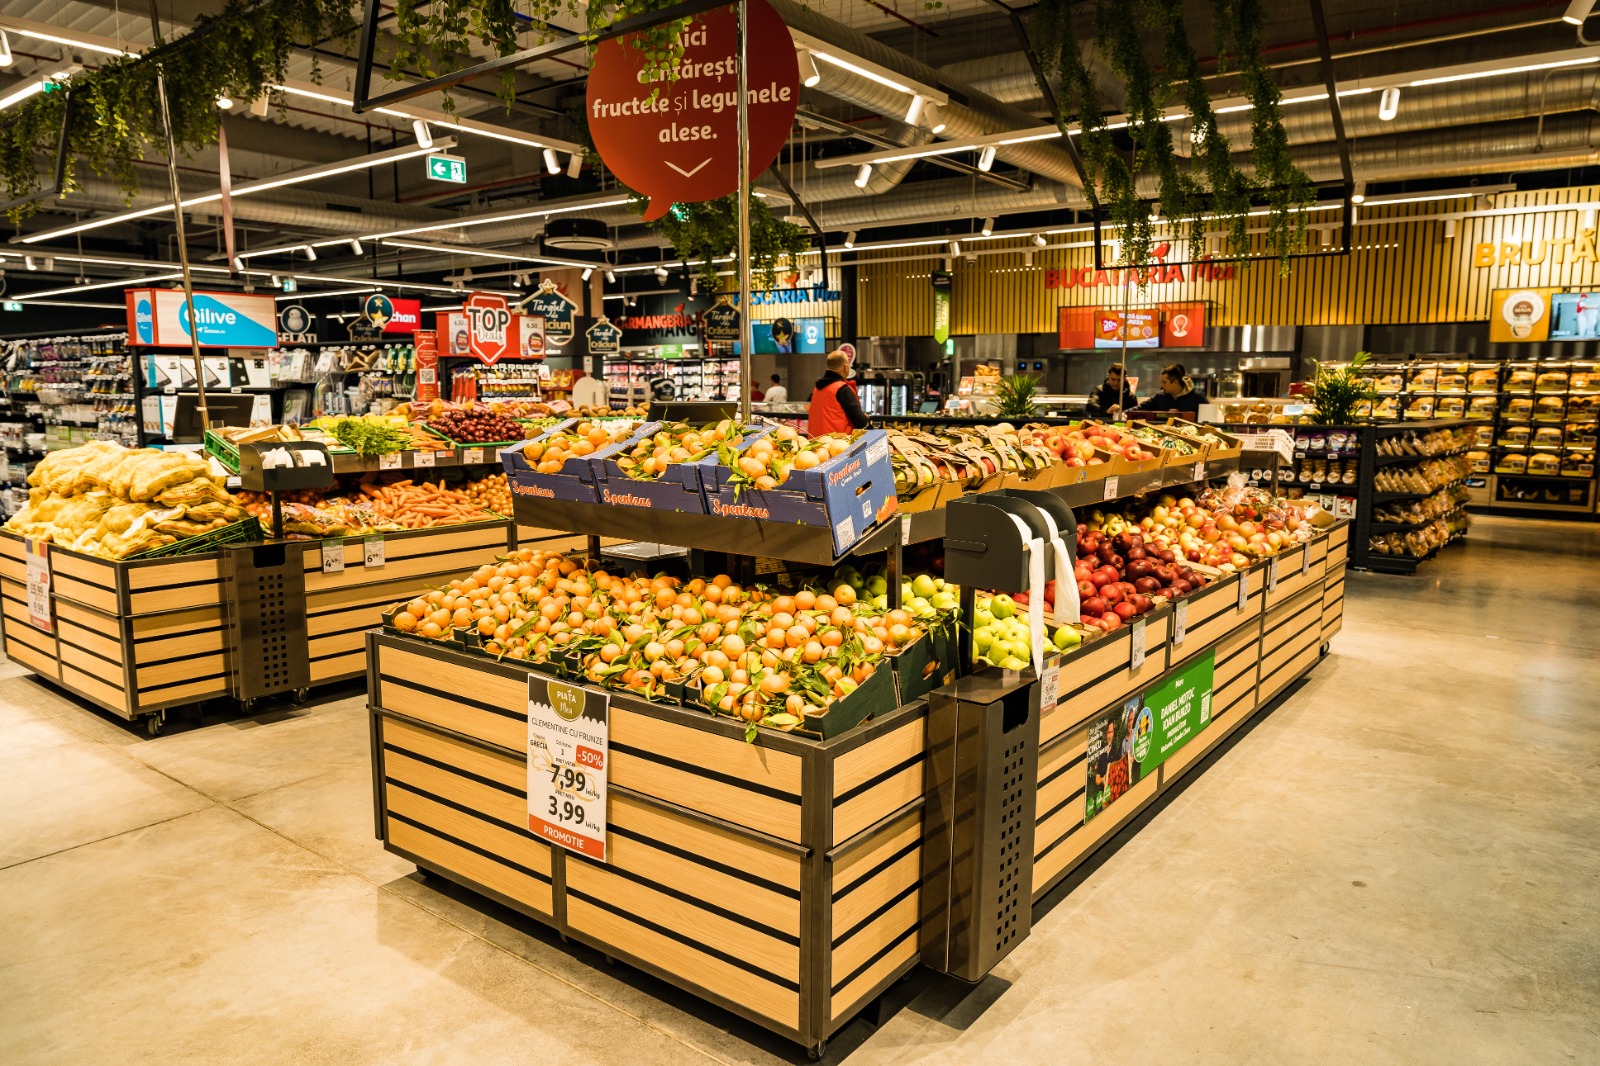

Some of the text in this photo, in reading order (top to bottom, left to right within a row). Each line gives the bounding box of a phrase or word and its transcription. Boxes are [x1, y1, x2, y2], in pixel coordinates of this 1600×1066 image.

[593, 81, 791, 119] fructele și legumele
[658, 122, 718, 143] alese.
[733, 283, 810, 306] PSCĂRIA
[184, 308, 236, 325] Qilive
[391, 311, 416, 323] chan
[532, 299, 566, 317] Târgul
[468, 308, 509, 332] TOP
[545, 319, 571, 330] ciun
[614, 314, 692, 330] CARMANGERIA
[477, 324, 505, 344] Deals
[713, 500, 770, 520] Spentzas
[532, 717, 603, 746] CLEMENTINE CU FRUNZE
[530, 739, 548, 750] GRECIA
[577, 750, 603, 768] -50%
[550, 763, 586, 792] 7,99
[548, 795, 585, 825] 3,99
[543, 825, 584, 849] PROMOTIE
